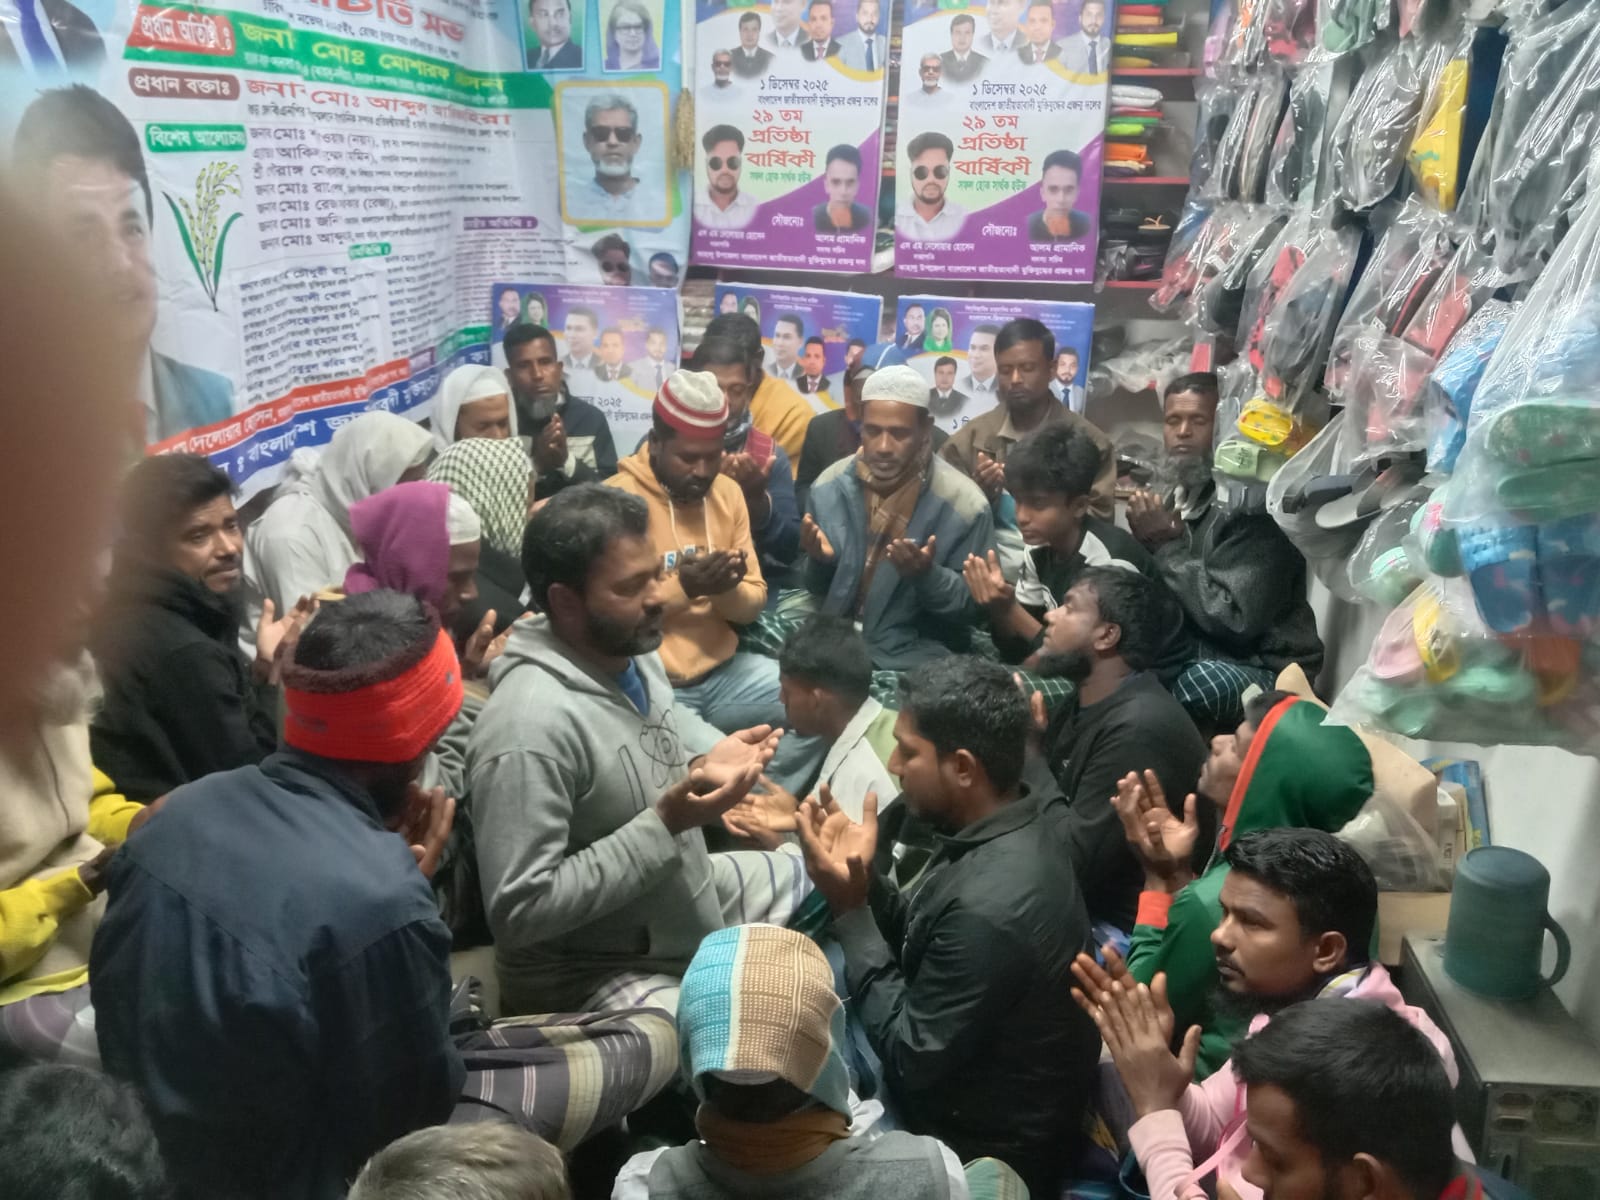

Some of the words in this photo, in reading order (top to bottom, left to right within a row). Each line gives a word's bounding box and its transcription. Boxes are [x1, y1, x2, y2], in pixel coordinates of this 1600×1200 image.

[239, 22, 294, 49] জনা
[134, 75, 180, 93] প্রধান
[760, 80, 765, 90] ১
[768, 75, 800, 90] ডিসেম্বর
[803, 80, 829, 91] ২০২৫
[972, 83, 978, 96] ১
[982, 80, 1016, 96] ডিসেম্বর
[1019, 83, 1047, 97] ২০২৫
[311, 90, 360, 107] মোঃ
[752, 109, 773, 123] ২৯
[779, 110, 803, 122] তম
[963, 115, 986, 131] ২৯
[992, 116, 1019, 128] তম
[748, 126, 811, 144] প্রতিষ্ঠা
[957, 132, 1028, 151] প্রতিষ্ঠা
[744, 149, 816, 168] বার্ষিকী
[954, 156, 1032, 175] বার্ষিকী
